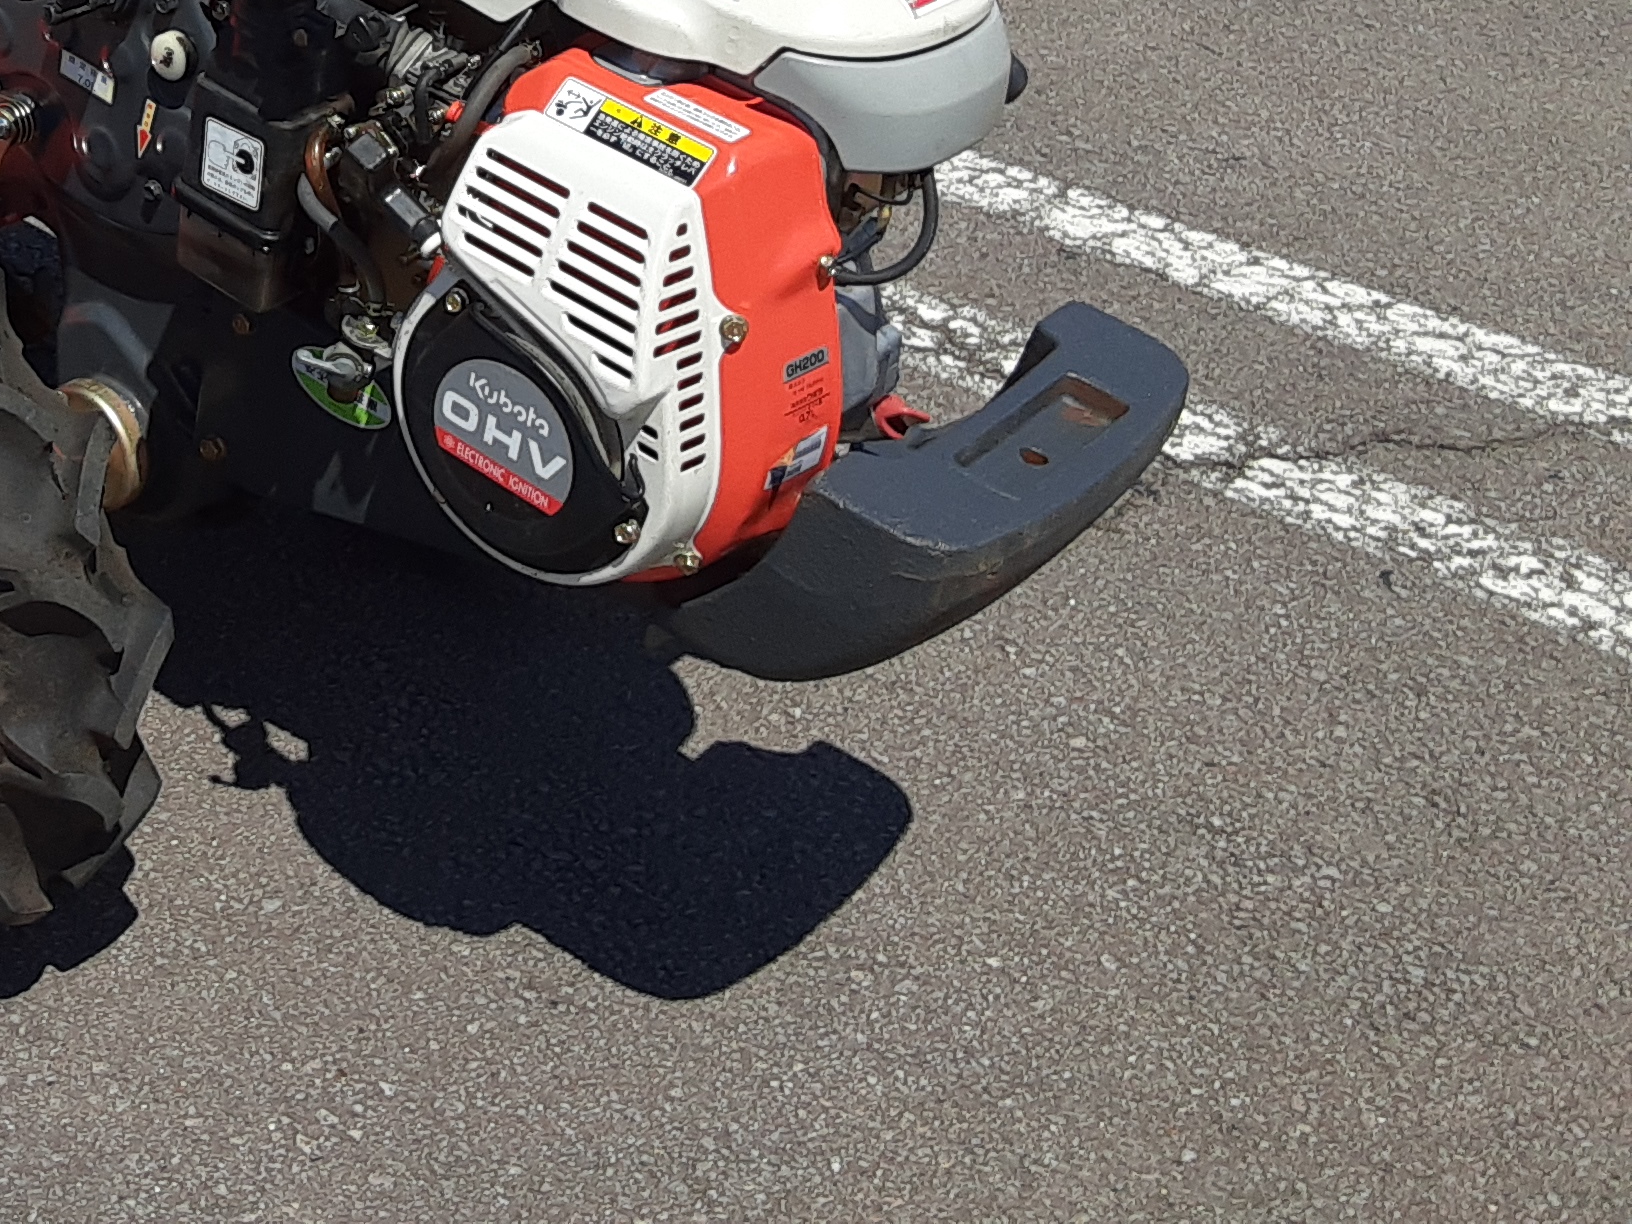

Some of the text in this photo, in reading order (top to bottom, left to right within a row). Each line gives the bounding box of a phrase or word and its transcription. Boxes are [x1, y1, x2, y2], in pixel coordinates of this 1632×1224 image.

[785, 348, 826, 379] GH200
[442, 390, 568, 481] OHV
[468, 371, 550, 438] Kubota
[456, 442, 550, 508] ELECTRONIC IGNITION
